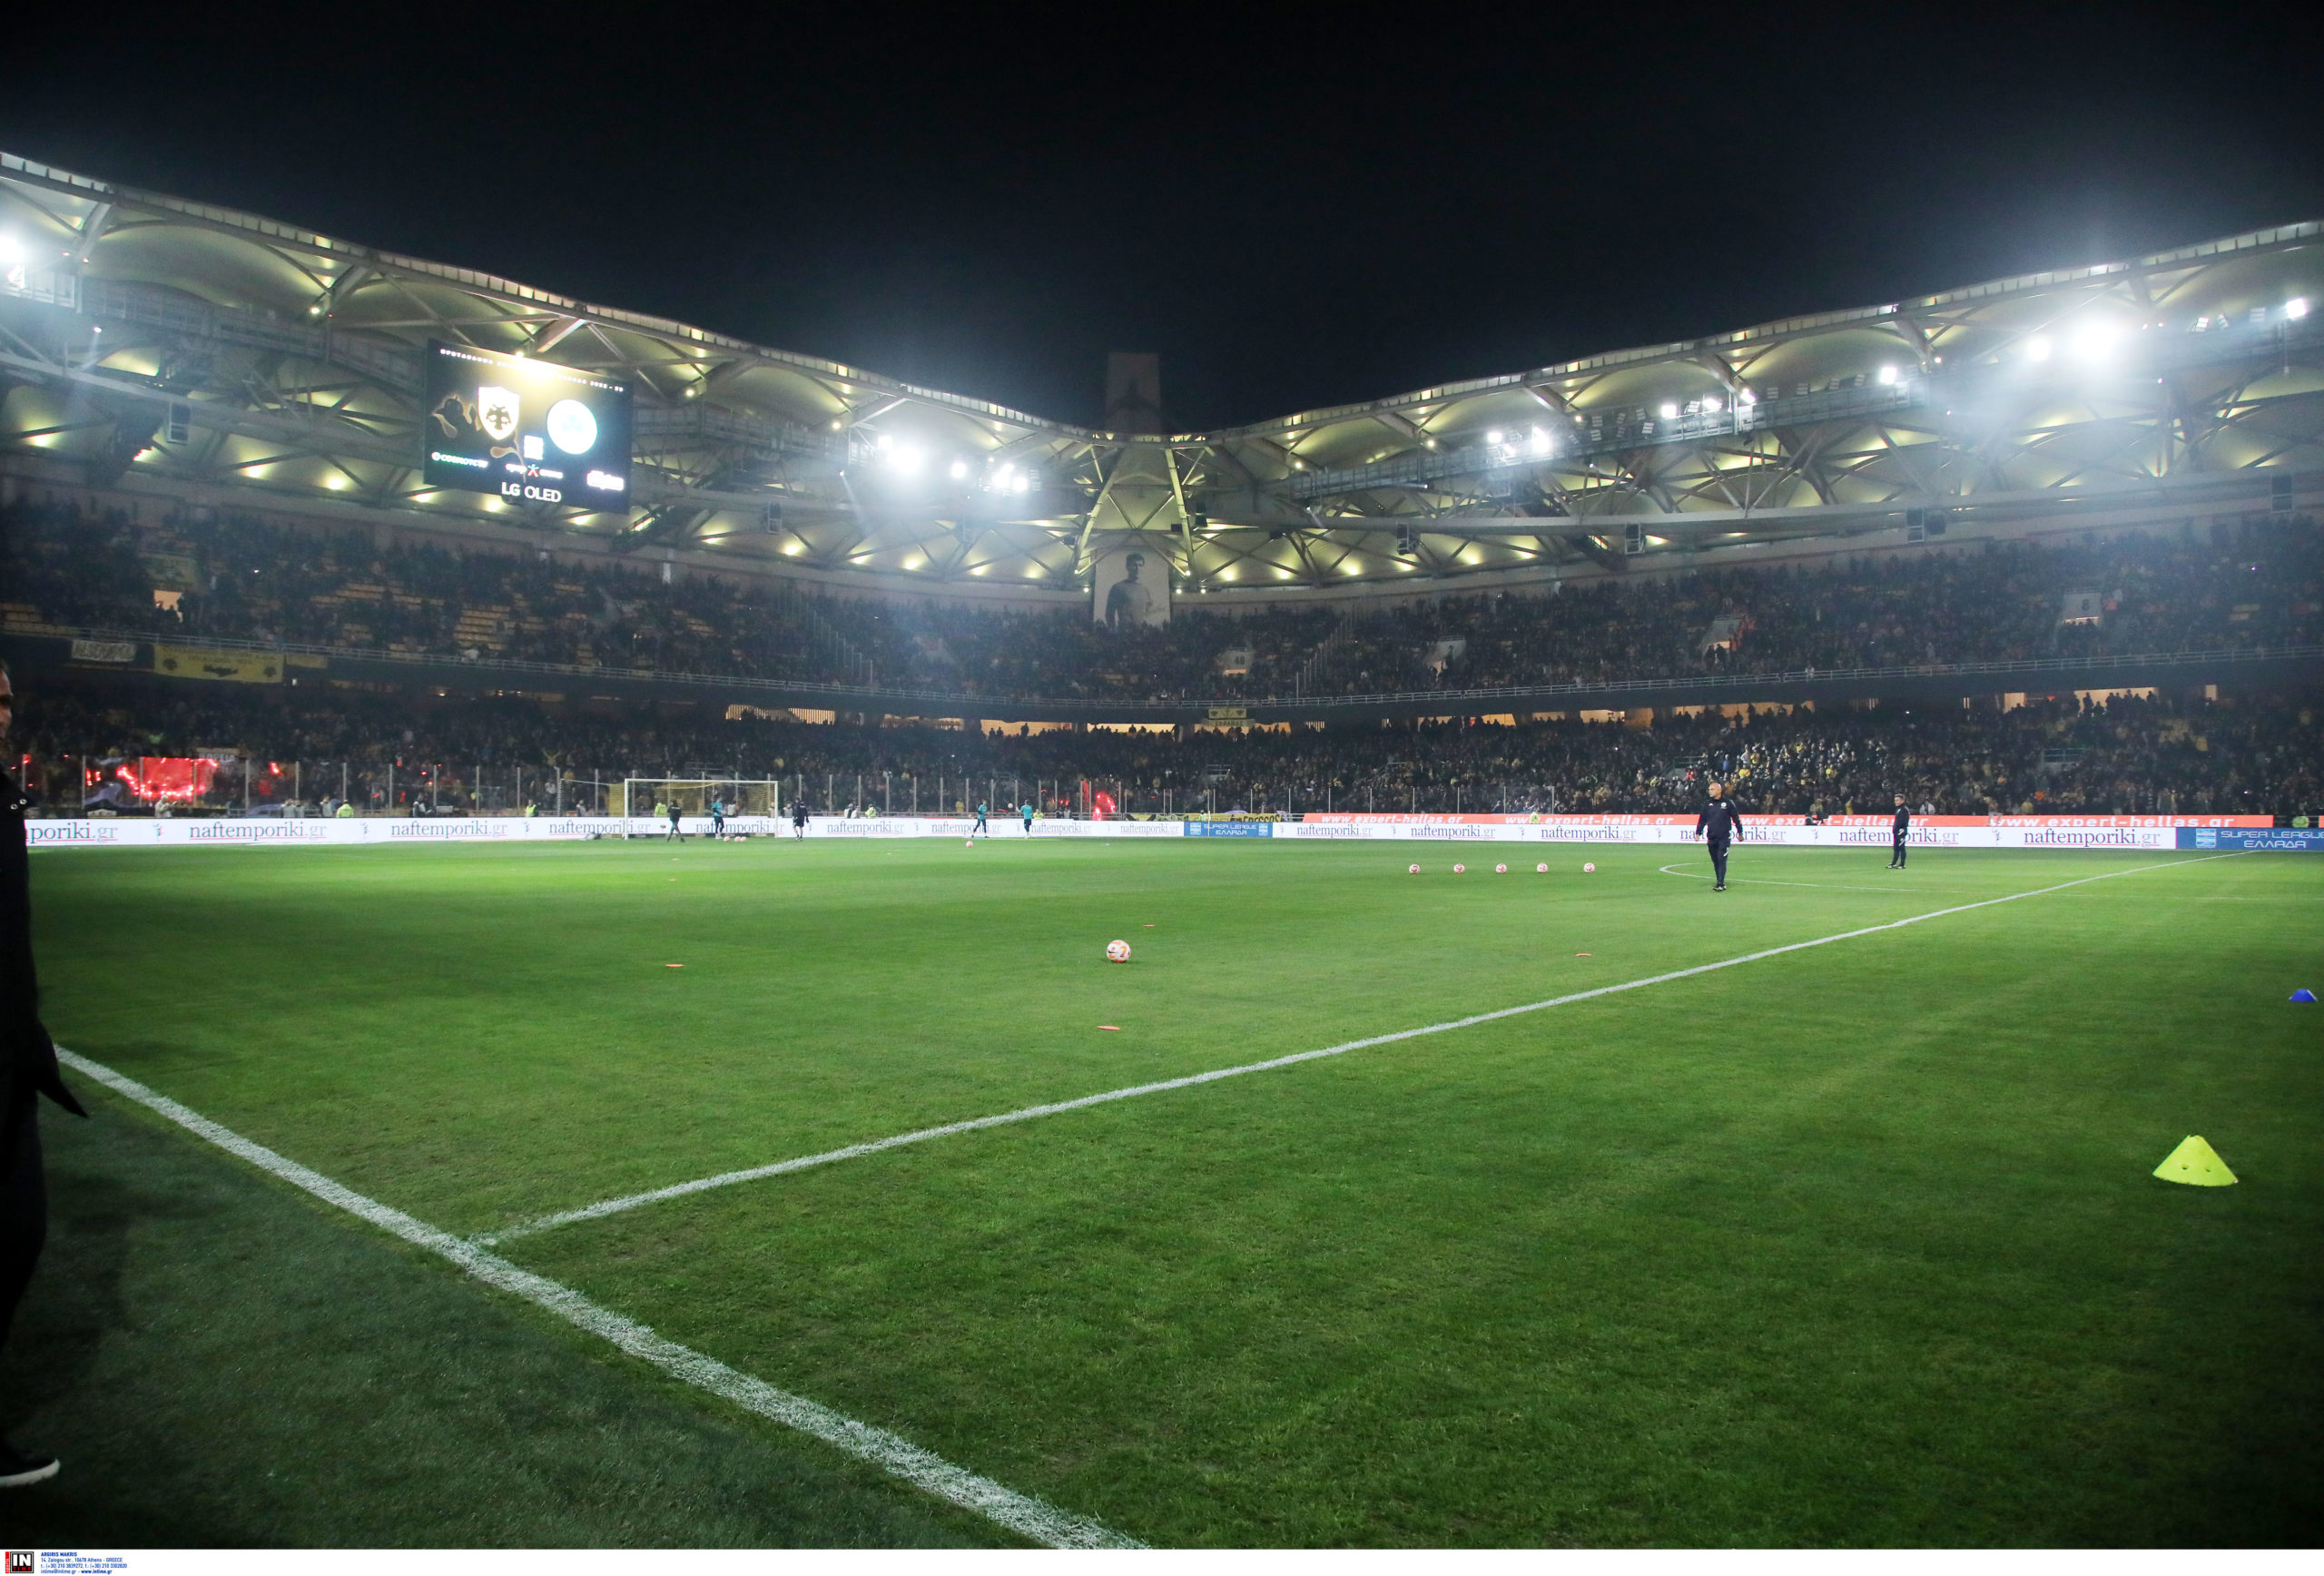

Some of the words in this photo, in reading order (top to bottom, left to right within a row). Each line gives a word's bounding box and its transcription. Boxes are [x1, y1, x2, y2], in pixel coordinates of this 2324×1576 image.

[501, 481, 520, 496] LG
[524, 486, 562, 503] OLED
[827, 821, 904, 835] naftemporiki.gr
[1505, 815, 1674, 824] ww.expert-hellas.gr
[189, 822, 327, 841] naftemporiki.gr
[390, 821, 508, 839] naftemporiki.gr
[1296, 824, 1373, 838] naftemporiki.gr
[1410, 824, 1496, 840] naftemporiki.gr
[1541, 825, 1637, 842] naftemporiki.gr
[1840, 827, 1959, 845] naftemoriki.gr
[2024, 828, 2161, 848] naftemporiki.gr
[2221, 830, 2268, 839] SUPER
